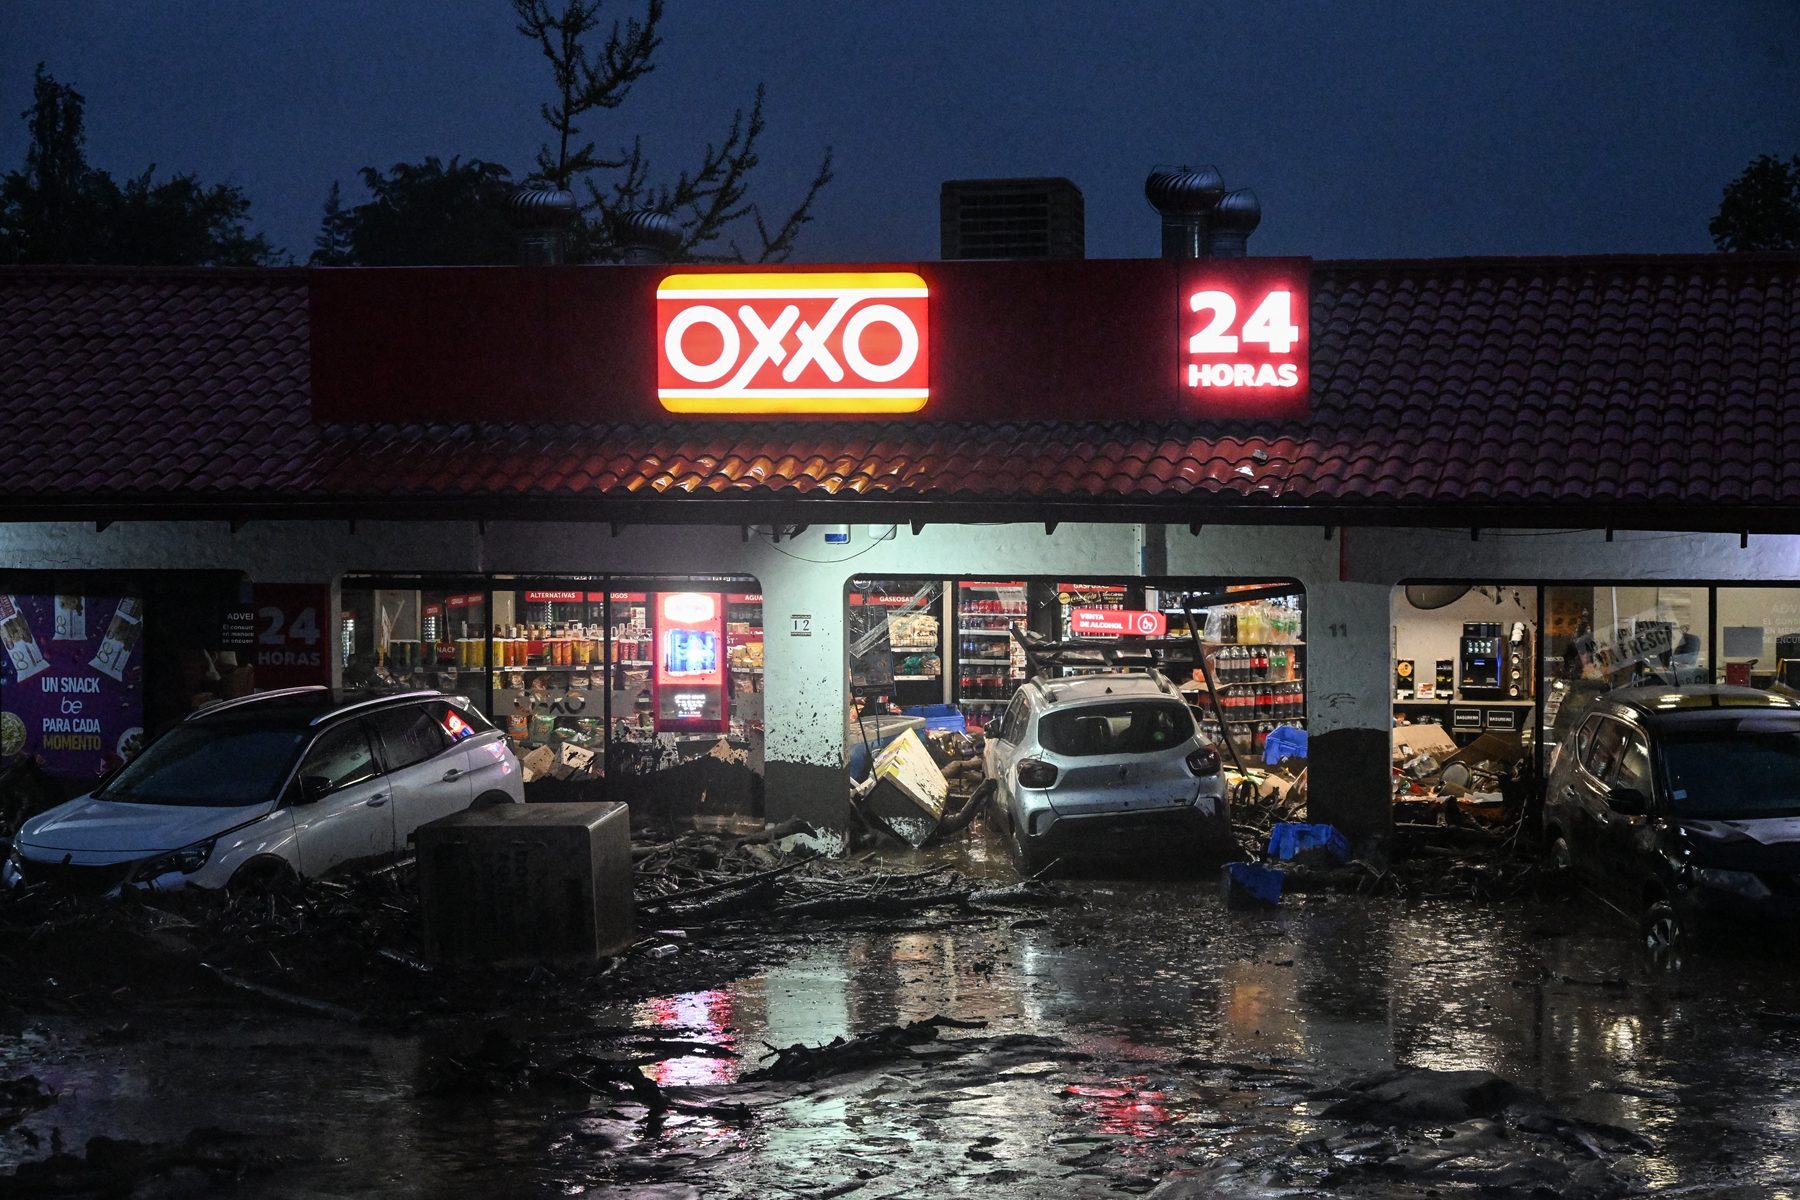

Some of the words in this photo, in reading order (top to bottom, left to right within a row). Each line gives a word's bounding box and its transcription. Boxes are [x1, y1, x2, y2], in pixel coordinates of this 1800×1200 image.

[1188, 290, 1299, 354] 24
[664, 302, 919, 389] OXXO
[1188, 363, 1299, 388] HORAS
[55, 615, 67, 635] be
[258, 606, 321, 645] 24
[1080, 613, 1104, 621] VENTA
[1091, 621, 1123, 630] ALCOHOL
[1329, 623, 1348, 637] 11
[12, 651, 29, 671] be
[96, 641, 113, 664] be
[258, 651, 321, 666] HORAS
[41, 676, 58, 693] UN
[60, 677, 100, 693] SNACK
[60, 696, 83, 714] be
[42, 718, 70, 732] PARA
[72, 718, 101, 733] CADA
[43, 734, 101, 750] MOMENTO
